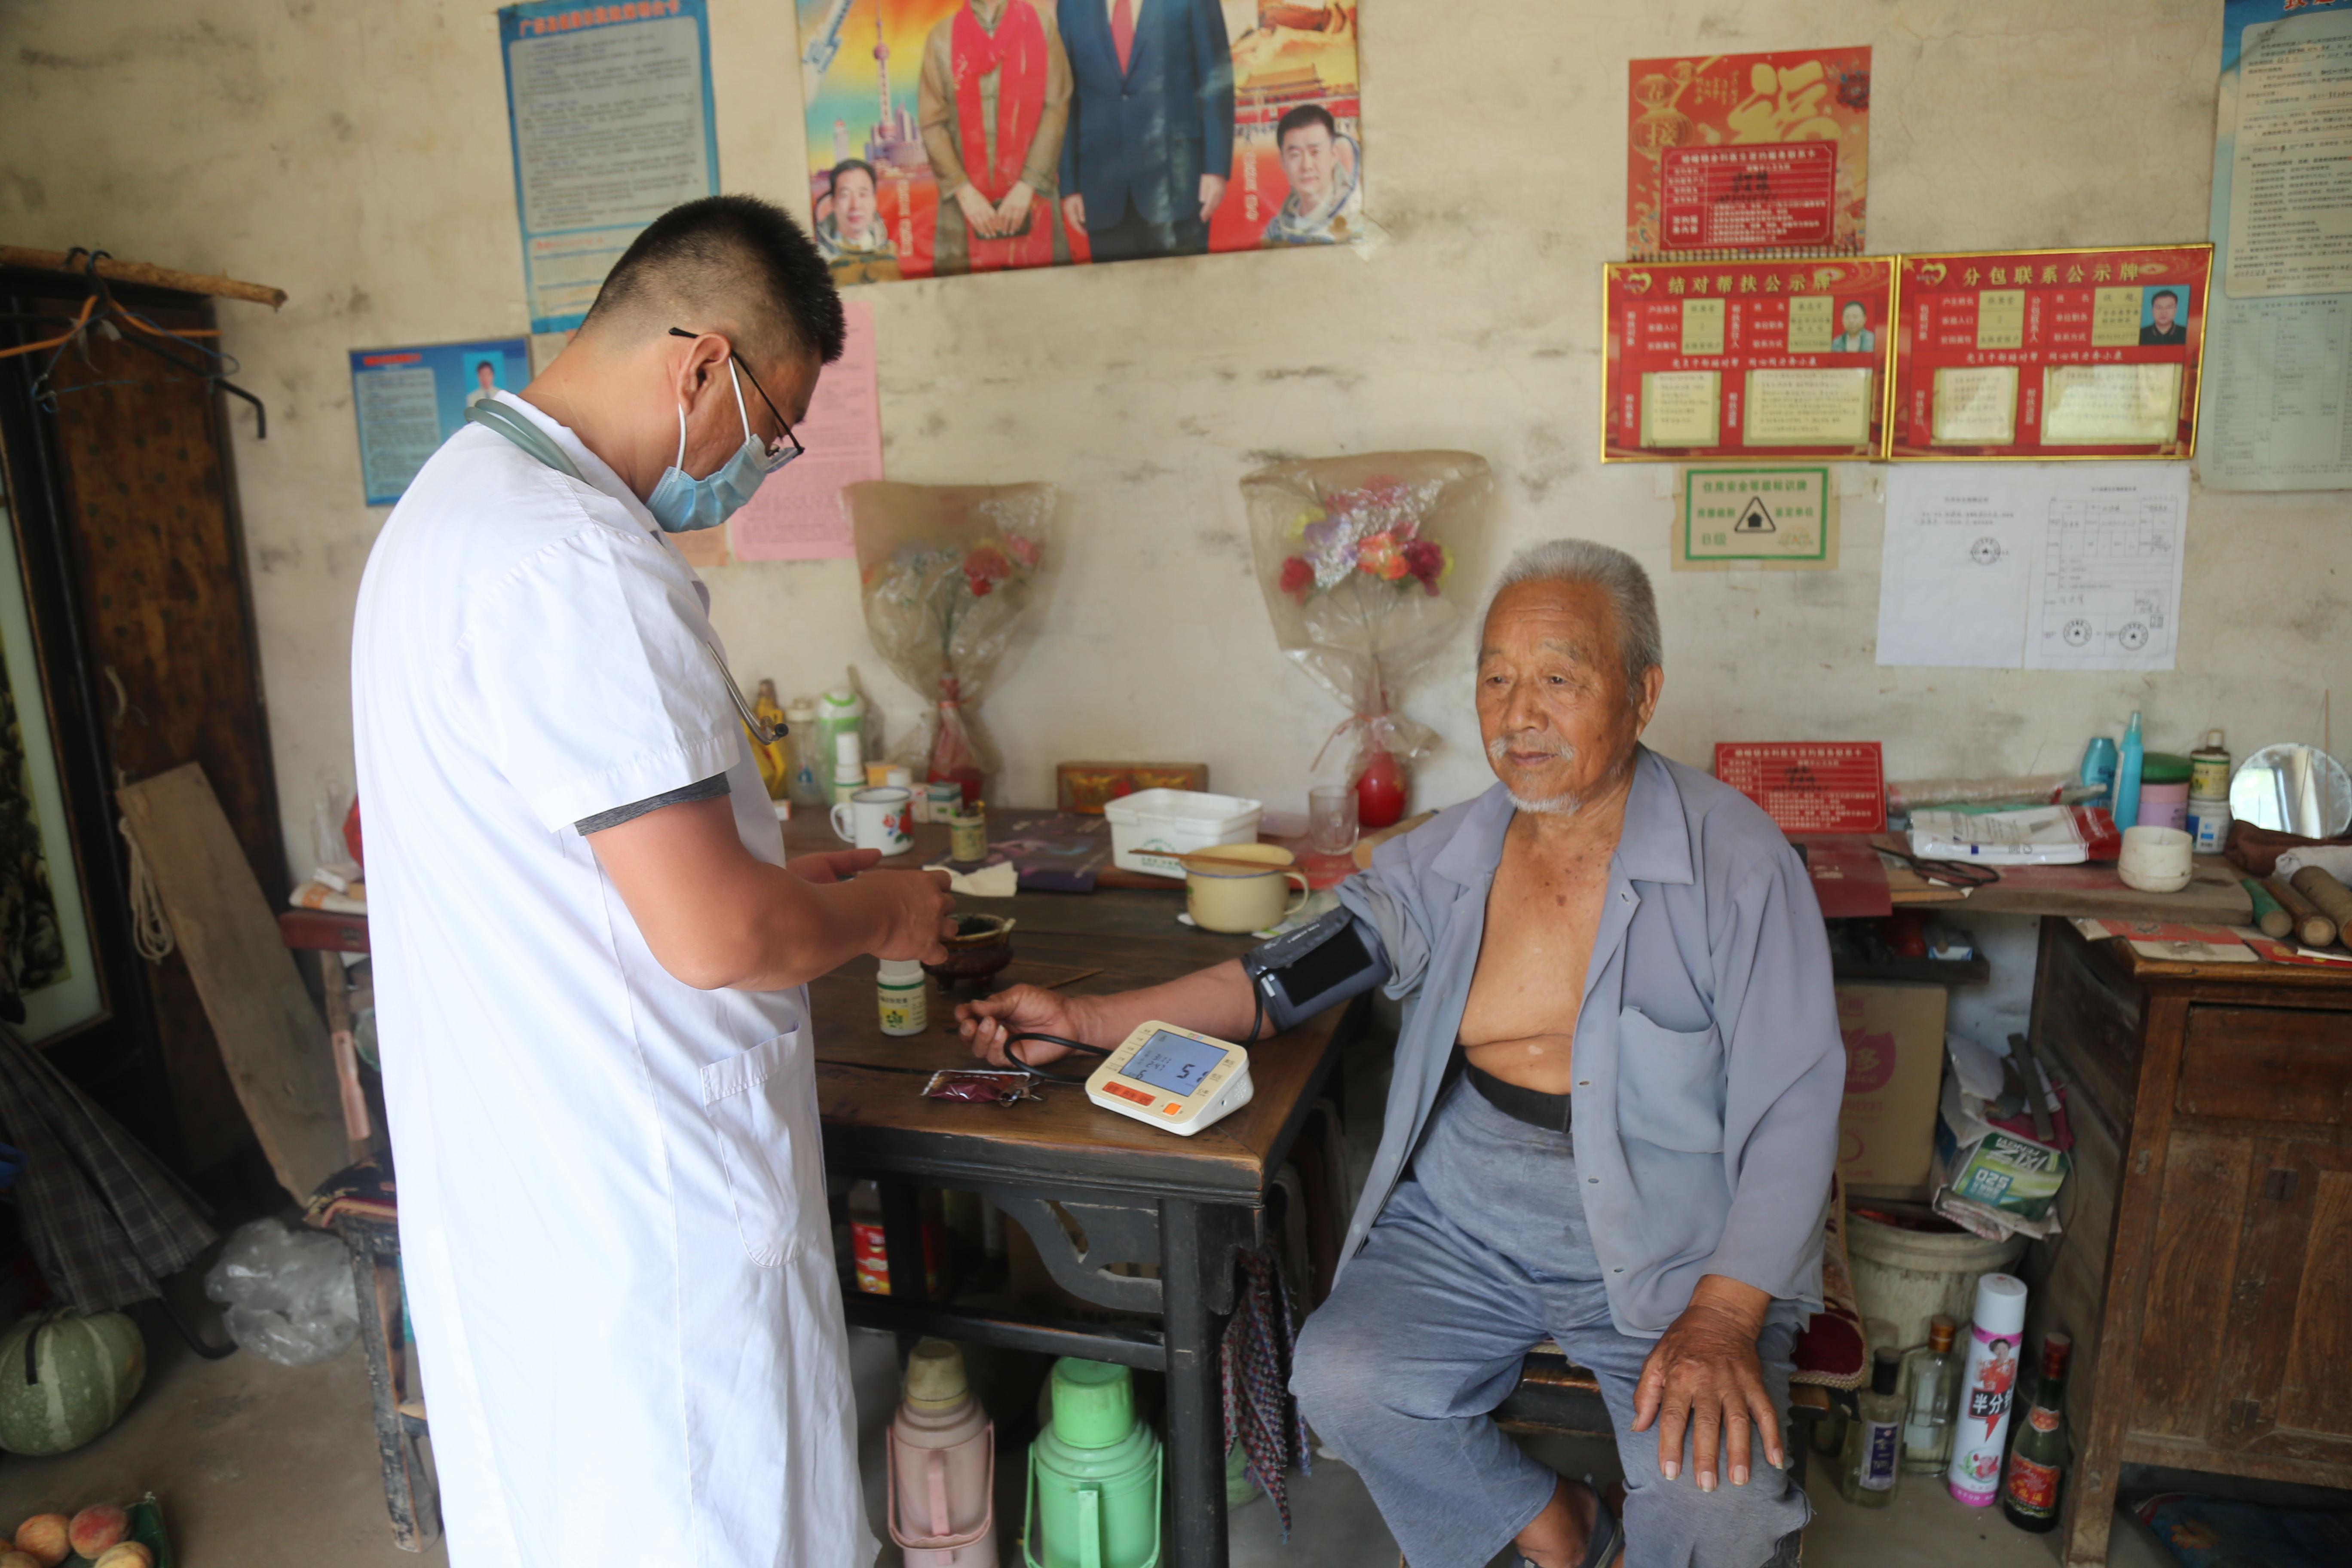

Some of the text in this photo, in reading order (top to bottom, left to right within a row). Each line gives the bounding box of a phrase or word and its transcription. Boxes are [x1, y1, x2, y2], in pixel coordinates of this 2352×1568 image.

[1667, 274, 1834, 295] 结对帮扶公示牌
[1963, 263, 2139, 287] 分包联系公示牌
